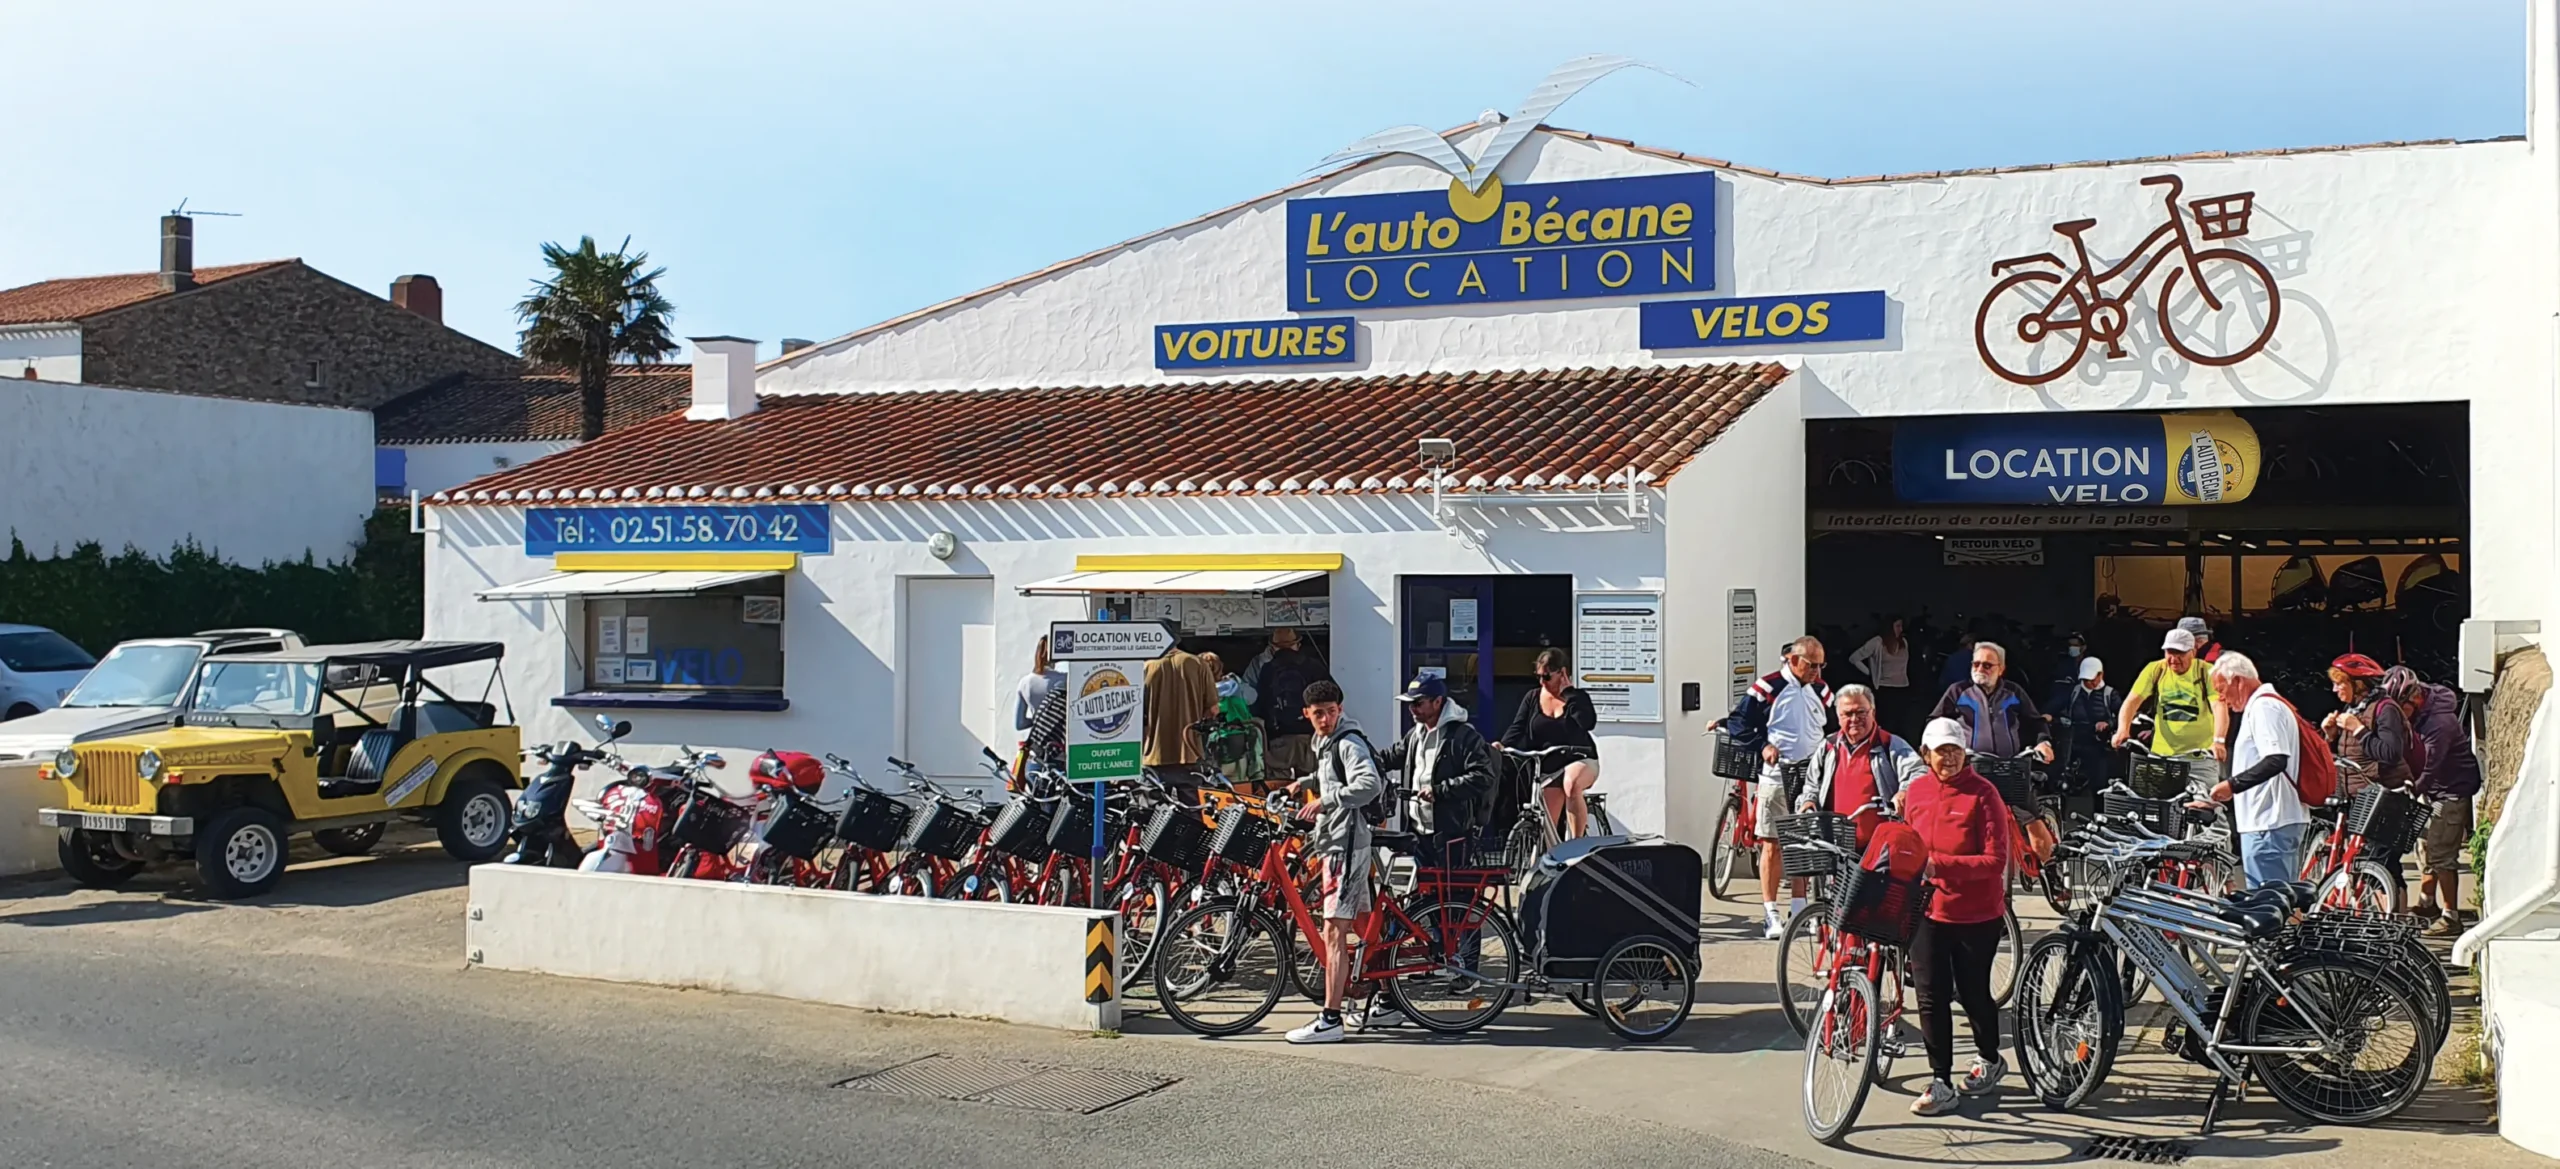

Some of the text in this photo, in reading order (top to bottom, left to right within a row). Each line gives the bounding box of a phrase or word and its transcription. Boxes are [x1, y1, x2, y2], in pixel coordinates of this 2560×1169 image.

[1307, 196, 1693, 256] L'auto Bécane
[1306, 247, 1694, 304] LOCATION
[1692, 301, 1831, 340] VELOS
[1161, 324, 1347, 361] VOITURES
[1946, 447, 2149, 480] LOCATION
[2048, 484, 2149, 503] VELO
[610, 514, 799, 544] 02.51.58.70.42
[1828, 513, 2172, 529] Interdiction de rouler sur la plage
[1951, 539, 2035, 549] RETOUR VELO
[1164, 604, 1172, 616] 2
[1075, 632, 1163, 643] LOCATION VELO
[654, 648, 744, 685] VELO
[1077, 696, 1105, 716] L'AUTO
[1091, 748, 1121, 758] OUVERT
[1078, 760, 1134, 771] TOUTE L'ANNEE
